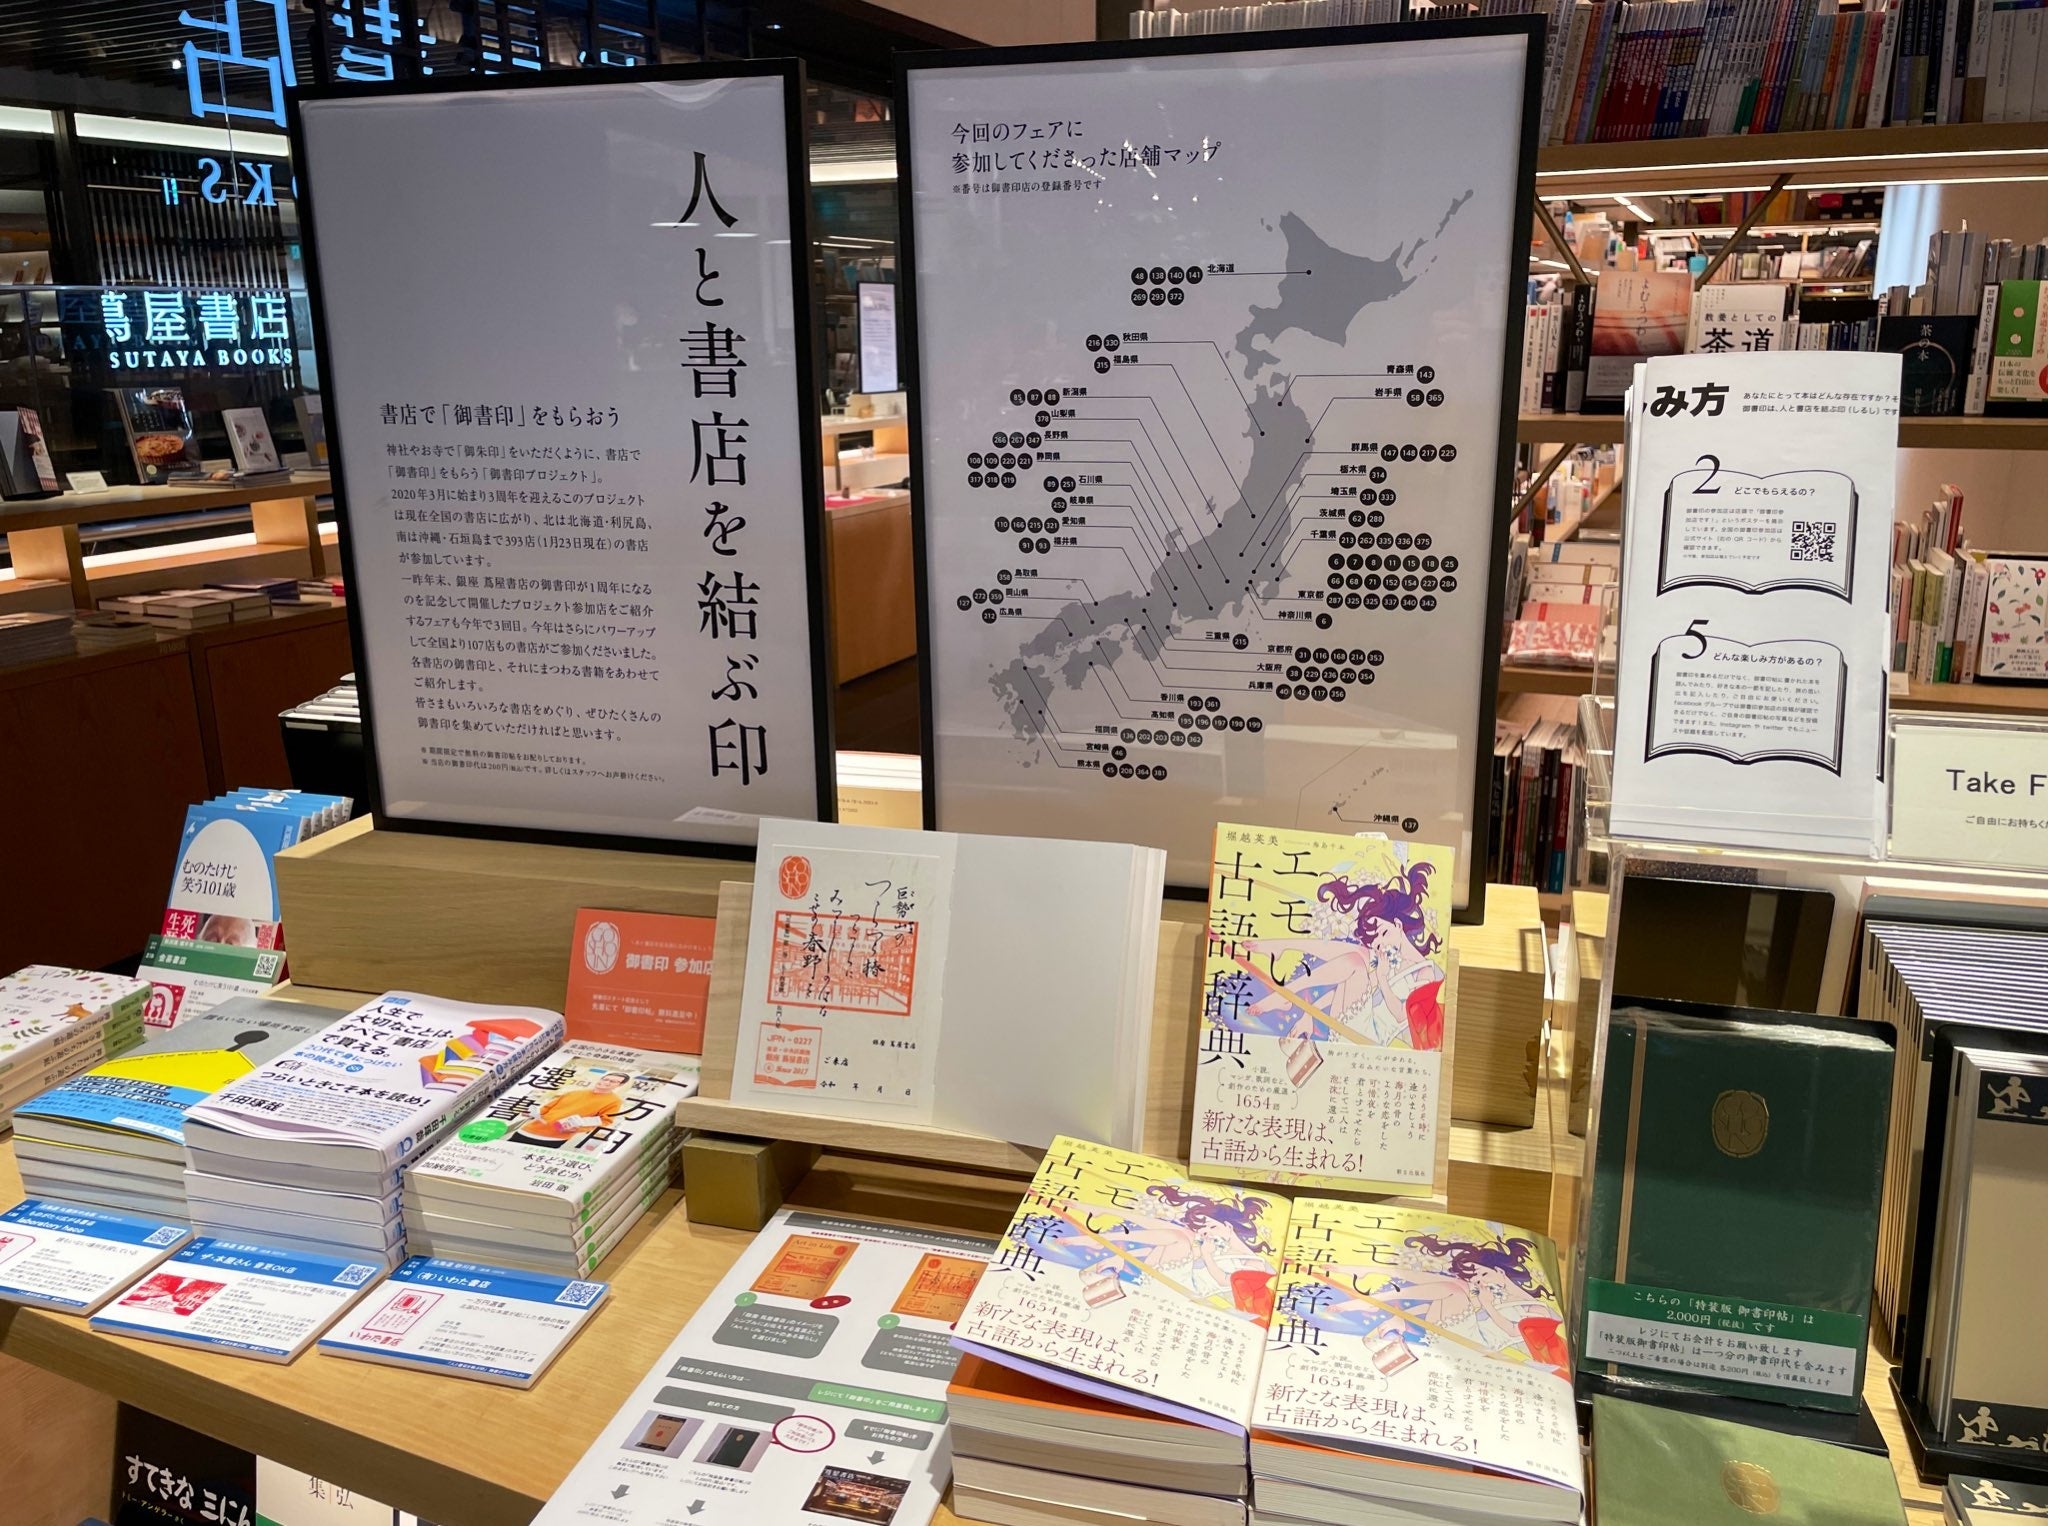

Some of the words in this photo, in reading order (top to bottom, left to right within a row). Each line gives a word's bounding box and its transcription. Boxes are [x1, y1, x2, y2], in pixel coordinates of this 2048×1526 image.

[951, 118, 1085, 145] 今回のフェアに
[951, 141, 1222, 175] 参加してくださった店舗マップ
[1207, 263, 1235, 273] 北海道
[102, 291, 290, 344] 蔦屋書店
[1704, 312, 1777, 323] 教養としての
[1122, 333, 1148, 342] 秋田県
[1700, 328, 1776, 353] 茶道
[1917, 323, 1934, 363] 茶の本
[218, 348, 293, 367] BOOKS
[1113, 355, 1139, 364] 福島県
[1386, 365, 1414, 374] 青森県
[1374, 387, 1402, 397] 岩手県
[1643, 382, 1730, 419] み方
[380, 403, 621, 428] 書店で「御書印」をもらおう
[1051, 409, 1076, 418] 山梨県
[1044, 431, 1068, 440] 長野県
[386, 444, 641, 462] 神社やお寺で「御朱印」をいただくように、書店で
[1351, 443, 1378, 452] 群馬県
[388, 466, 603, 484] 「御書印」をもらう「御書印プロジェクト」。
[673, 150, 768, 787] 人と書店を結ぶ印
[1340, 465, 1367, 474] 栃木県
[1691, 454, 1722, 495] 2
[1078, 475, 1103, 484] 石川県
[391, 489, 646, 507] 2020年3月に始まり3周年を迎えるこのプロジェクト
[1069, 496, 1094, 505] 岐阜県
[1330, 487, 1357, 496] 埼玉県
[1734, 487, 1816, 497] どこでもらえるの？
[395, 510, 654, 530] は現在全国の書店に広がり、北は北海道・利尻島、
[1061, 517, 1086, 526] 愛知県
[1319, 508, 1346, 517] 茨城県
[1053, 537, 1078, 546] 福井県
[1310, 530, 1337, 539] 千葉県
[399, 551, 492, 568] が参加しています。
[1014, 568, 1038, 577] 鳥取県
[1005, 588, 1029, 597] 岡山県
[1298, 590, 1325, 599] 東京都
[404, 594, 654, 618] のを記念して開催したプロジェクト参加店をご紹介
[1000, 608, 1023, 617] 広島県
[1278, 611, 1312, 620] 神奈川県
[406, 615, 657, 639] するフェアも今年で3回目。今年はさらにパワーアップ
[1205, 631, 1230, 640] 三重県
[1681, 619, 1710, 660] 5
[410, 636, 658, 662] して全国より107店もの書店がご参加くださいました。
[1267, 645, 1293, 654] 京都府
[1256, 663, 1282, 672] 大阪府
[1712, 651, 1823, 667] どんな楽しみ方があるの？
[411, 656, 660, 682] 各書店の御書印と、それにまつわる書籍をあわせて
[414, 677, 485, 693] ご紹介します。
[1248, 681, 1274, 691] 兵庫県
[1160, 693, 1185, 702] 香川県
[415, 696, 662, 723] 皆さまもいろいろな書店をめぐり、ぜひたくさんの
[1151, 711, 1175, 720] 高知県
[418, 716, 623, 743] 御書印を集めていただければと思います。
[1095, 725, 1118, 735] 福岡県
[1086, 742, 1109, 752] 宮崎県
[1077, 760, 1101, 769] 熊本県
[1946, 768, 2016, 795] Take
[1372, 813, 1400, 823] 沖縄県
[1966, 815, 2048, 830] ご自由にお持ちく
[182, 860, 238, 879] むのたけじ
[181, 877, 237, 899] 笑う101歳
[1270, 849, 1319, 986] エモい
[1199, 851, 1263, 1070] 古語辞典
[366, 1004, 424, 1021] 人生で
[349, 1014, 455, 1040] 大切なことは、
[336, 1023, 441, 1050] すべて「書店」
[321, 1034, 391, 1058] で買える。
[1339, 1076, 1350, 1135] そして二人は
[1353, 1078, 1366, 1146] 君とすごせたら
[1379, 1080, 1391, 1151] ような恋をした
[1201, 1108, 1335, 1145] 新たな表現は、
[521, 1153, 593, 1174] 本をどう選び、
[523, 1162, 586, 1182] どう読むか。
[1084, 1160, 1150, 1236] エモい
[985, 1151, 1094, 1283] 古語辞典
[1351, 1215, 1404, 1296] エモい
[1266, 1212, 1342, 1357] 古語辞典
[973, 1300, 1126, 1359] 新たな表現は、
[1639, 1326, 1804, 1358] レジにてお会計をお願い致します
[1599, 1332, 1848, 1376] 「特装版御書印帖」は一つ分の御書印代を含みます
[1266, 1383, 1438, 1426] 新たな表現は、
[124, 1454, 196, 1511] すてきな
[199, 1488, 252, 1526] 三にん
